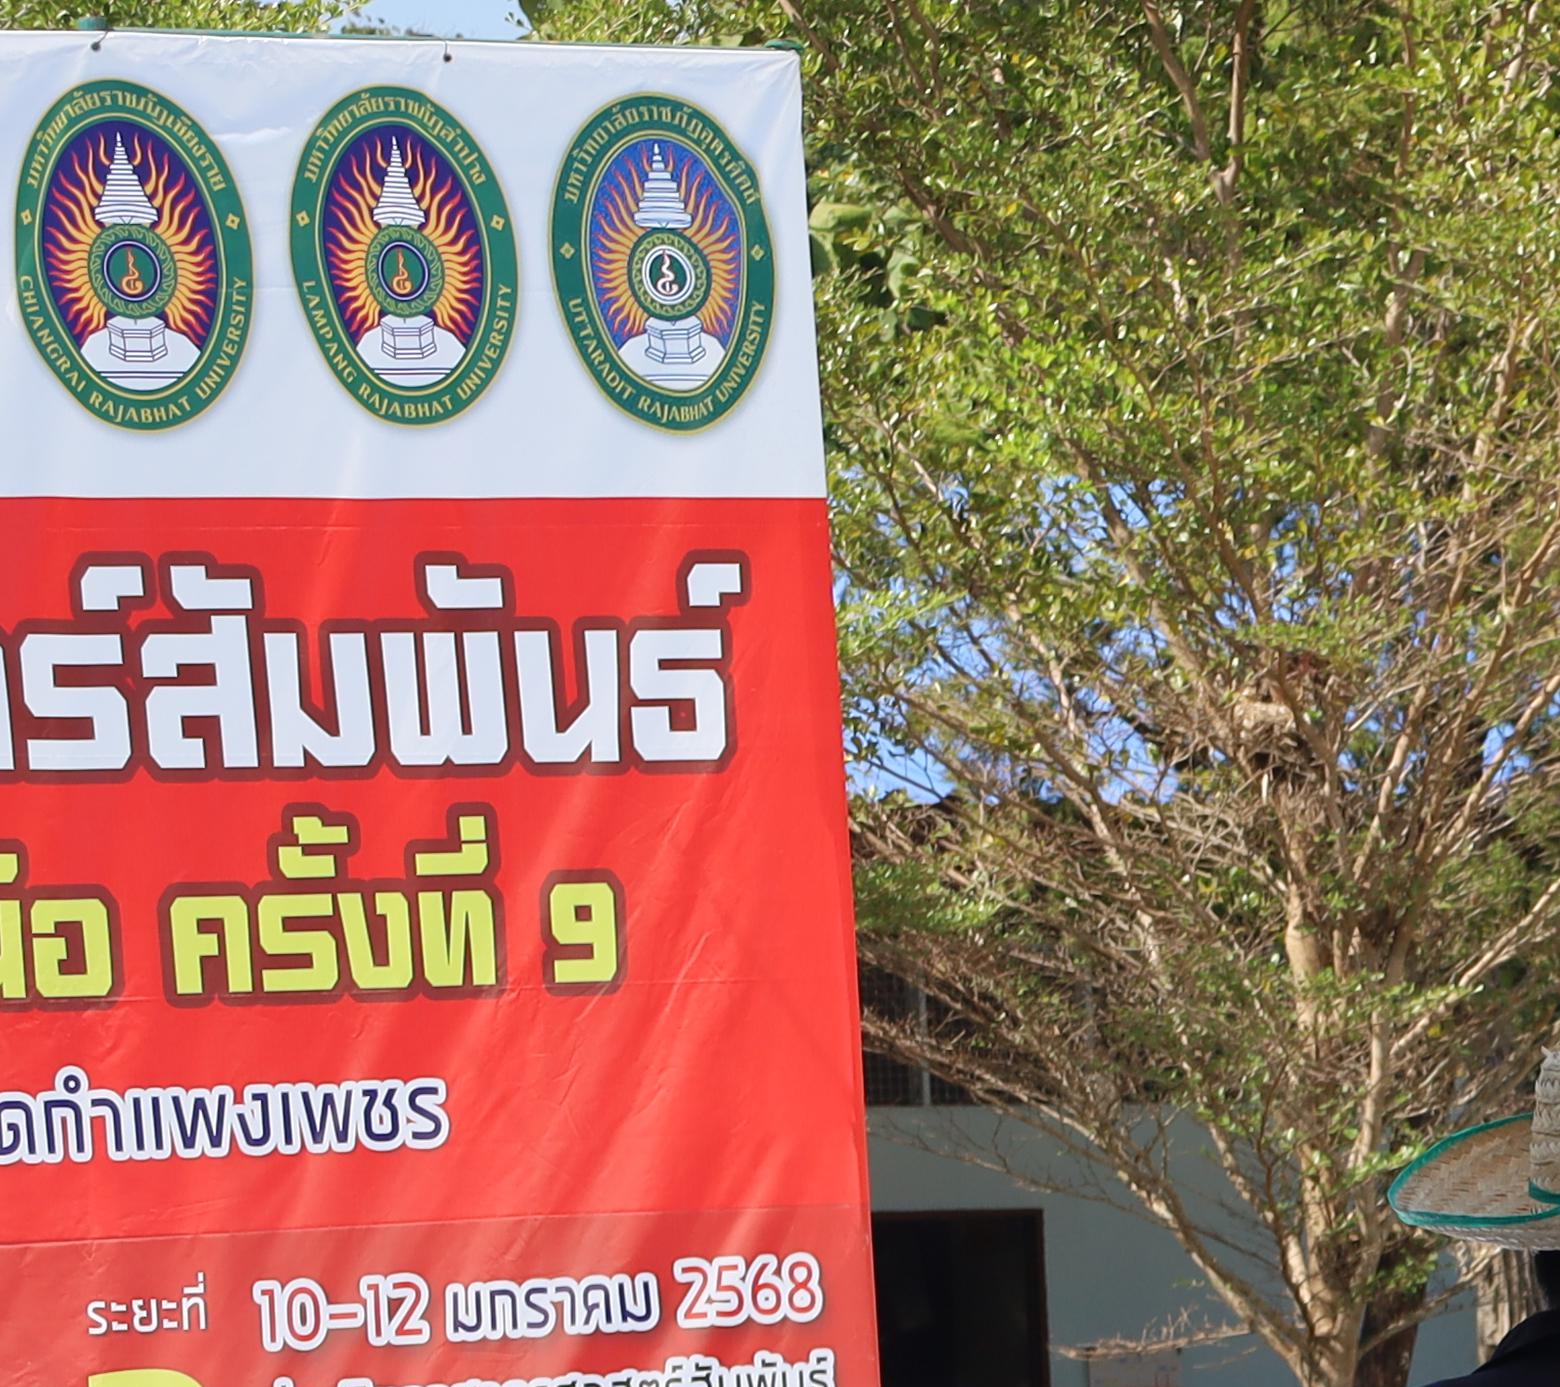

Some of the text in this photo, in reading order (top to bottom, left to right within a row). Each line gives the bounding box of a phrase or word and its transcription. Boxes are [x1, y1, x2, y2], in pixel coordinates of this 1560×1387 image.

[20, 275, 247, 423] CHIANGRAI RAJABHAT UNIVERSITY
[302, 280, 512, 418] LAMPANG RAJABHAT UNIVERSITY
[568, 298, 766, 423] UTTARADIT RAJABHAT UNIVERSITY
[0, 563, 742, 771] ร์สัมพันธ์
[169, 816, 498, 996] ครั้งที่
[550, 883, 617, 983] 9
[86, 1271, 206, 1334] ระยะที่
[449, 1277, 657, 1337] มกราคม
[678, 1257, 820, 1324] 2568
